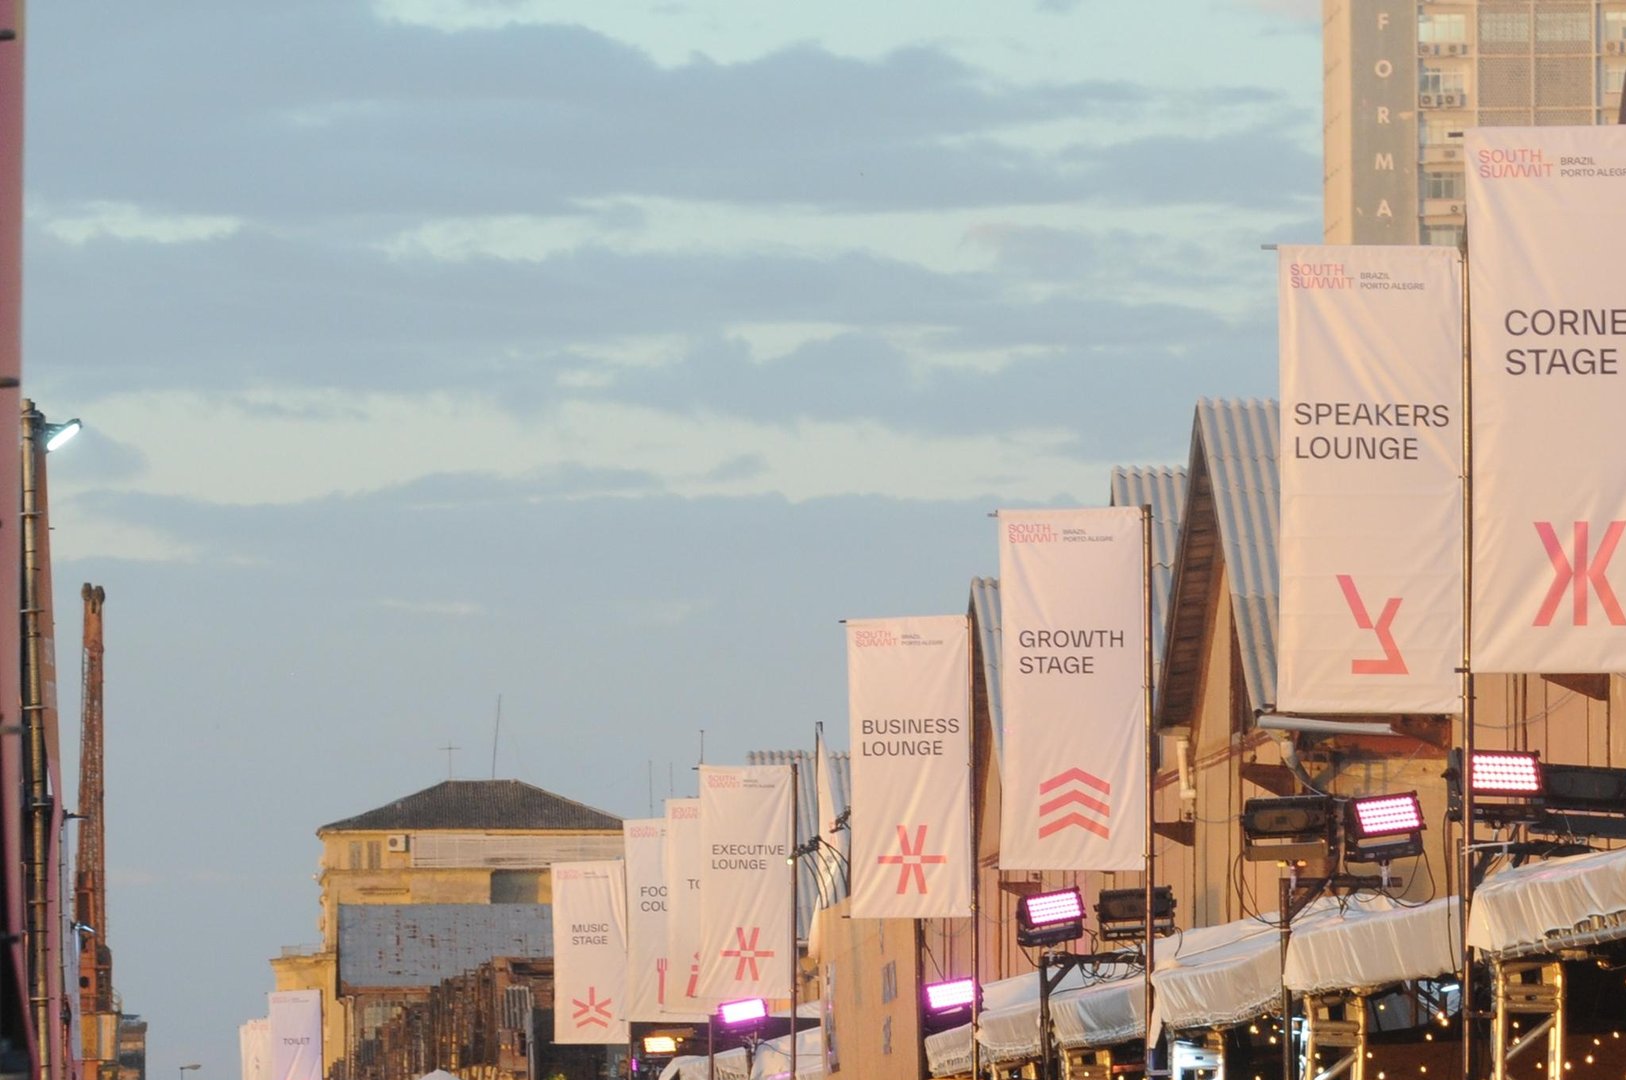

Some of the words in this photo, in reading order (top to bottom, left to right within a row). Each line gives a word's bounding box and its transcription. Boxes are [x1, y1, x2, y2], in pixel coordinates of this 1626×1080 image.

[1478, 149, 1543, 164] SOUTH
[1560, 157, 1596, 166] BRAZIL
[1479, 163, 1554, 178] SUMMIT
[1560, 168, 1595, 178] PORTO
[1290, 263, 1345, 276] SOUTH
[1360, 272, 1390, 280] BRAZIL
[1290, 276, 1355, 289] SUMMIT
[1360, 282, 1390, 290] PORTO
[1505, 348, 1618, 376] STAGE
[1294, 402, 1450, 428] SPEAKERS
[1295, 436, 1419, 460] LOUNGE
[1008, 523, 1051, 534] SOUTH
[1019, 630, 1124, 648] GROWTH
[1019, 656, 1094, 674] STAGE
[862, 718, 960, 735] BUSINESS
[862, 740, 943, 756] LOUNGE
[712, 844, 785, 855] EXECUTIVE
[711, 859, 767, 870] LOUNGE
[640, 886, 668, 897] FOO
[640, 900, 668, 912] COU
[571, 923, 609, 933] MUSIC
[571, 935, 608, 946] STAGE
[283, 1037, 310, 1046] TOILET
